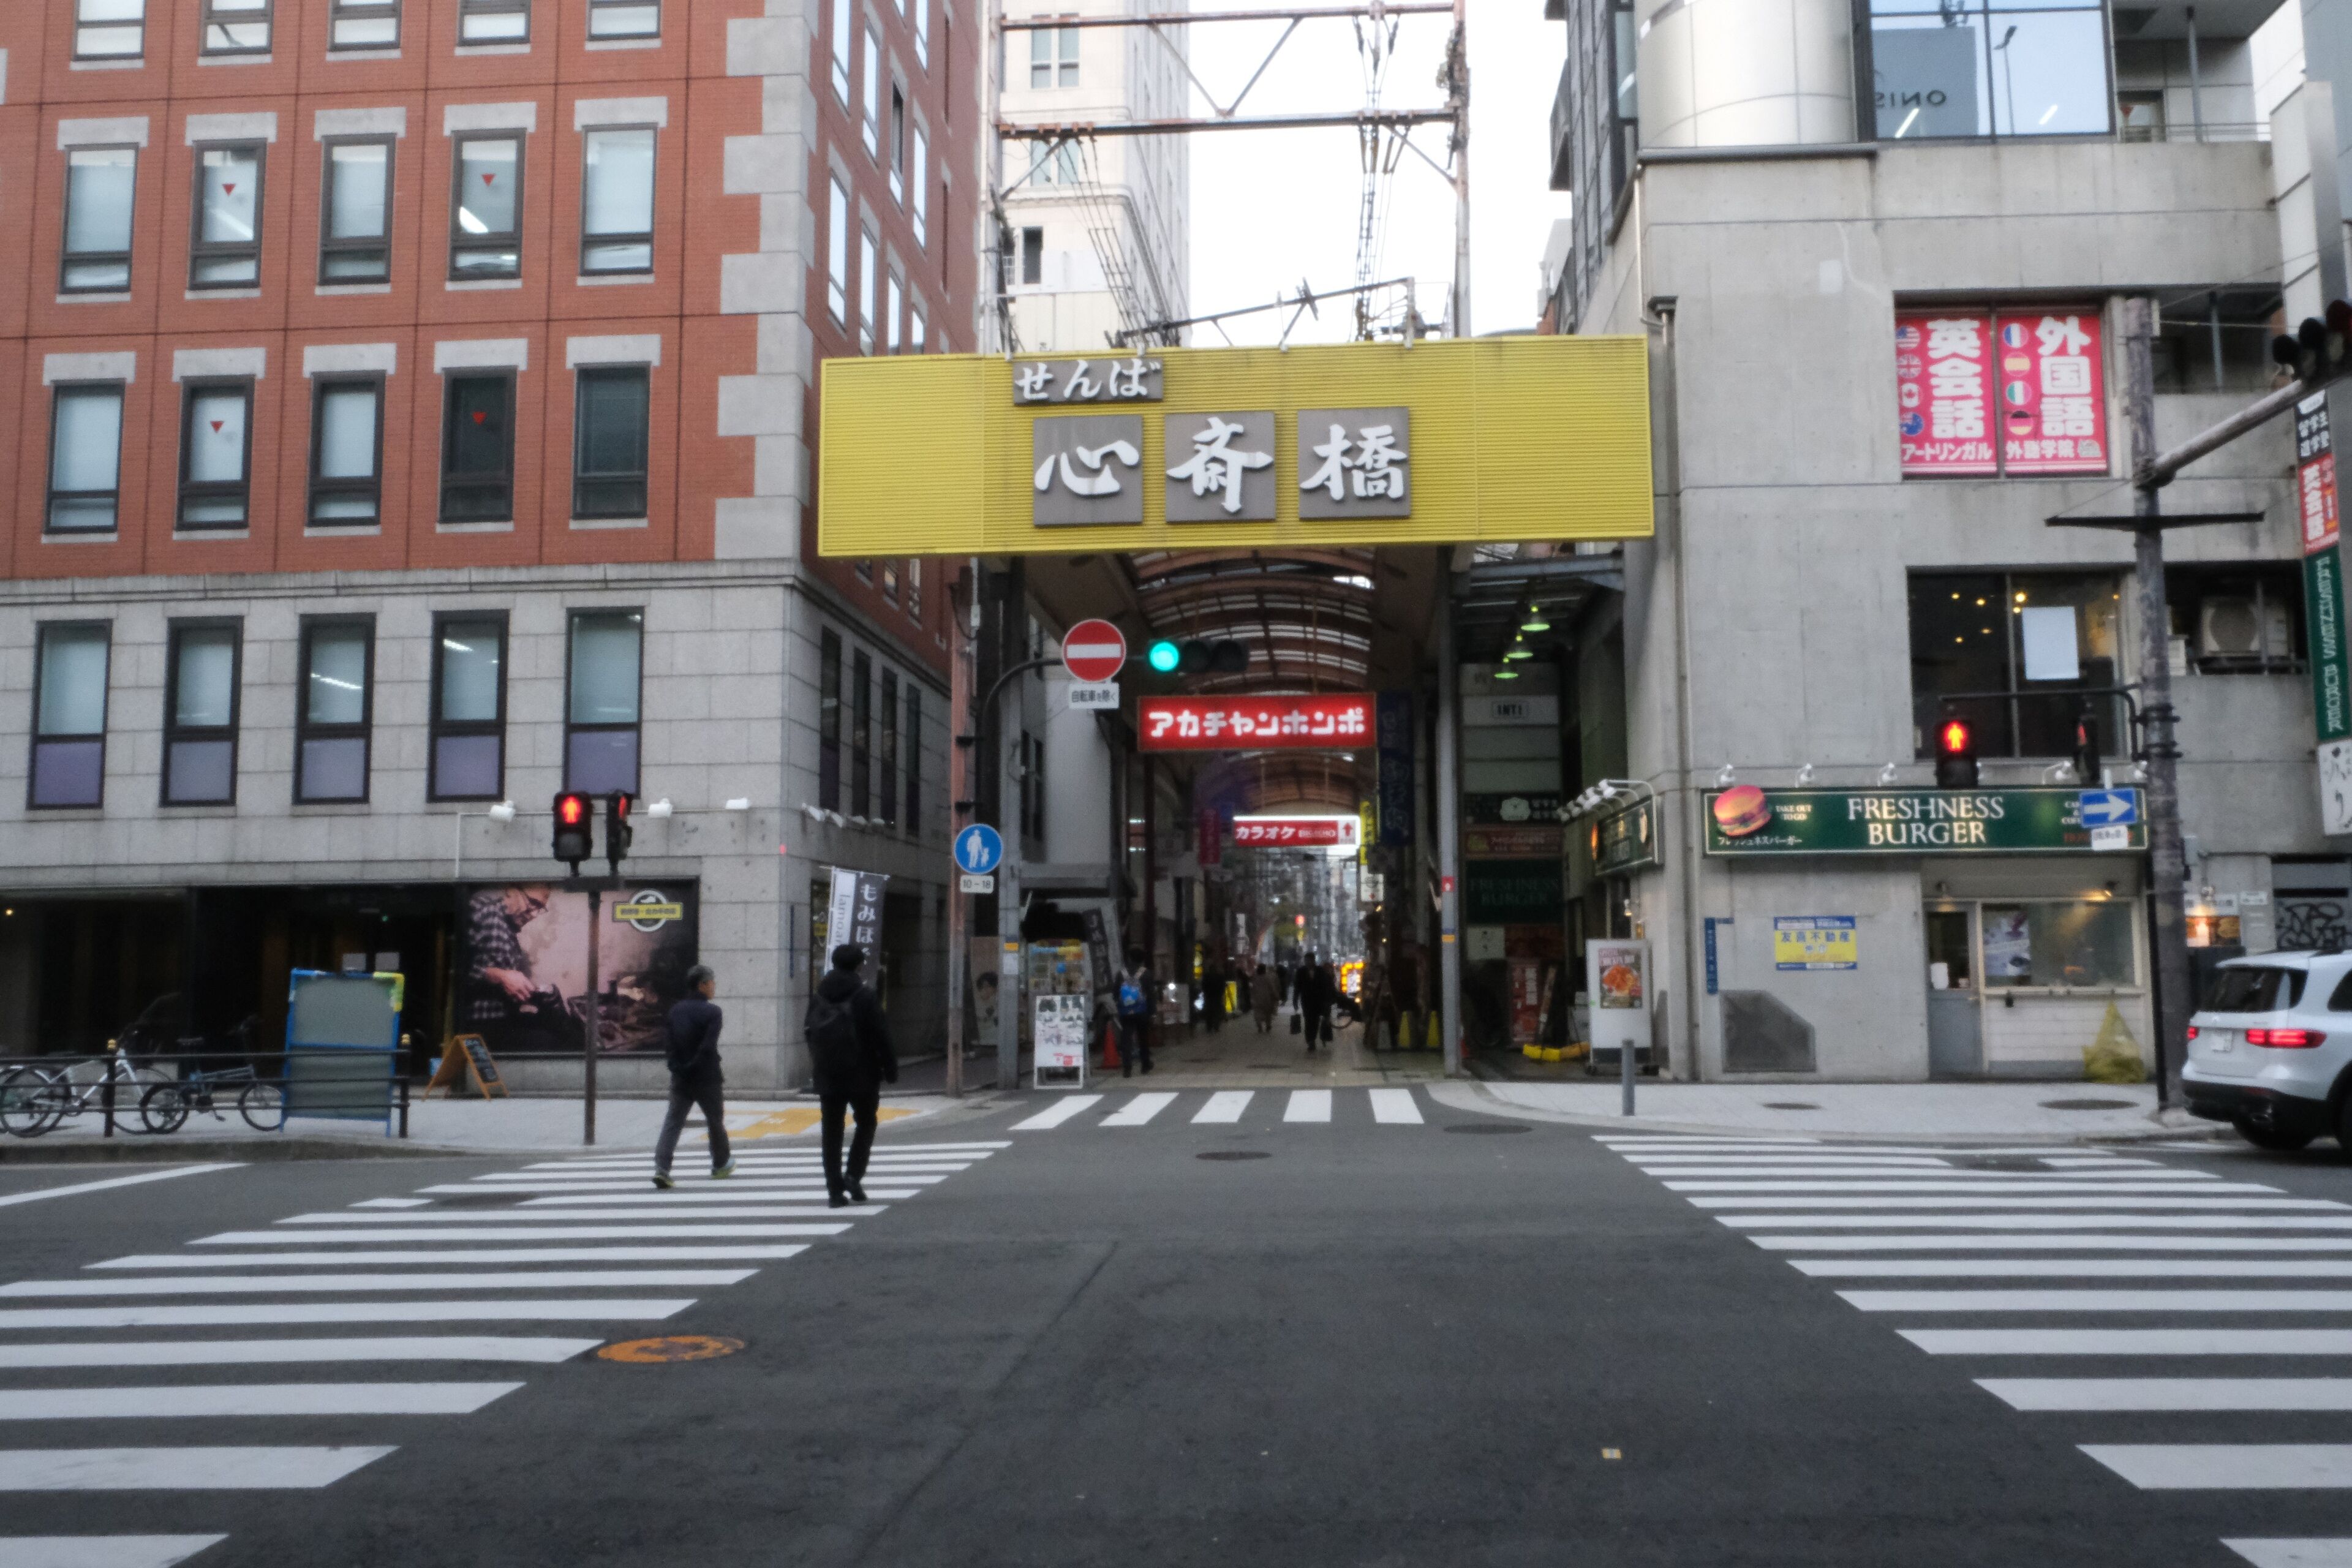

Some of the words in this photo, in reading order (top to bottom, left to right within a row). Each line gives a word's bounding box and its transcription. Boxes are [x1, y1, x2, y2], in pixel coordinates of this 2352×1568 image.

[1015, 358, 1161, 399] せんば
[1927, 318, 1985, 439] 英会話
[2035, 315, 2094, 437] 外国語
[1034, 417, 1408, 513] 心斎橋
[1901, 440, 1992, 461] アートリンガル
[1148, 707, 1366, 737] アカチャンホンポ
[1847, 796, 2005, 820] FRESHNESS
[1236, 826, 1296, 839] カラオケ
[1869, 821, 1987, 845] BURGER
